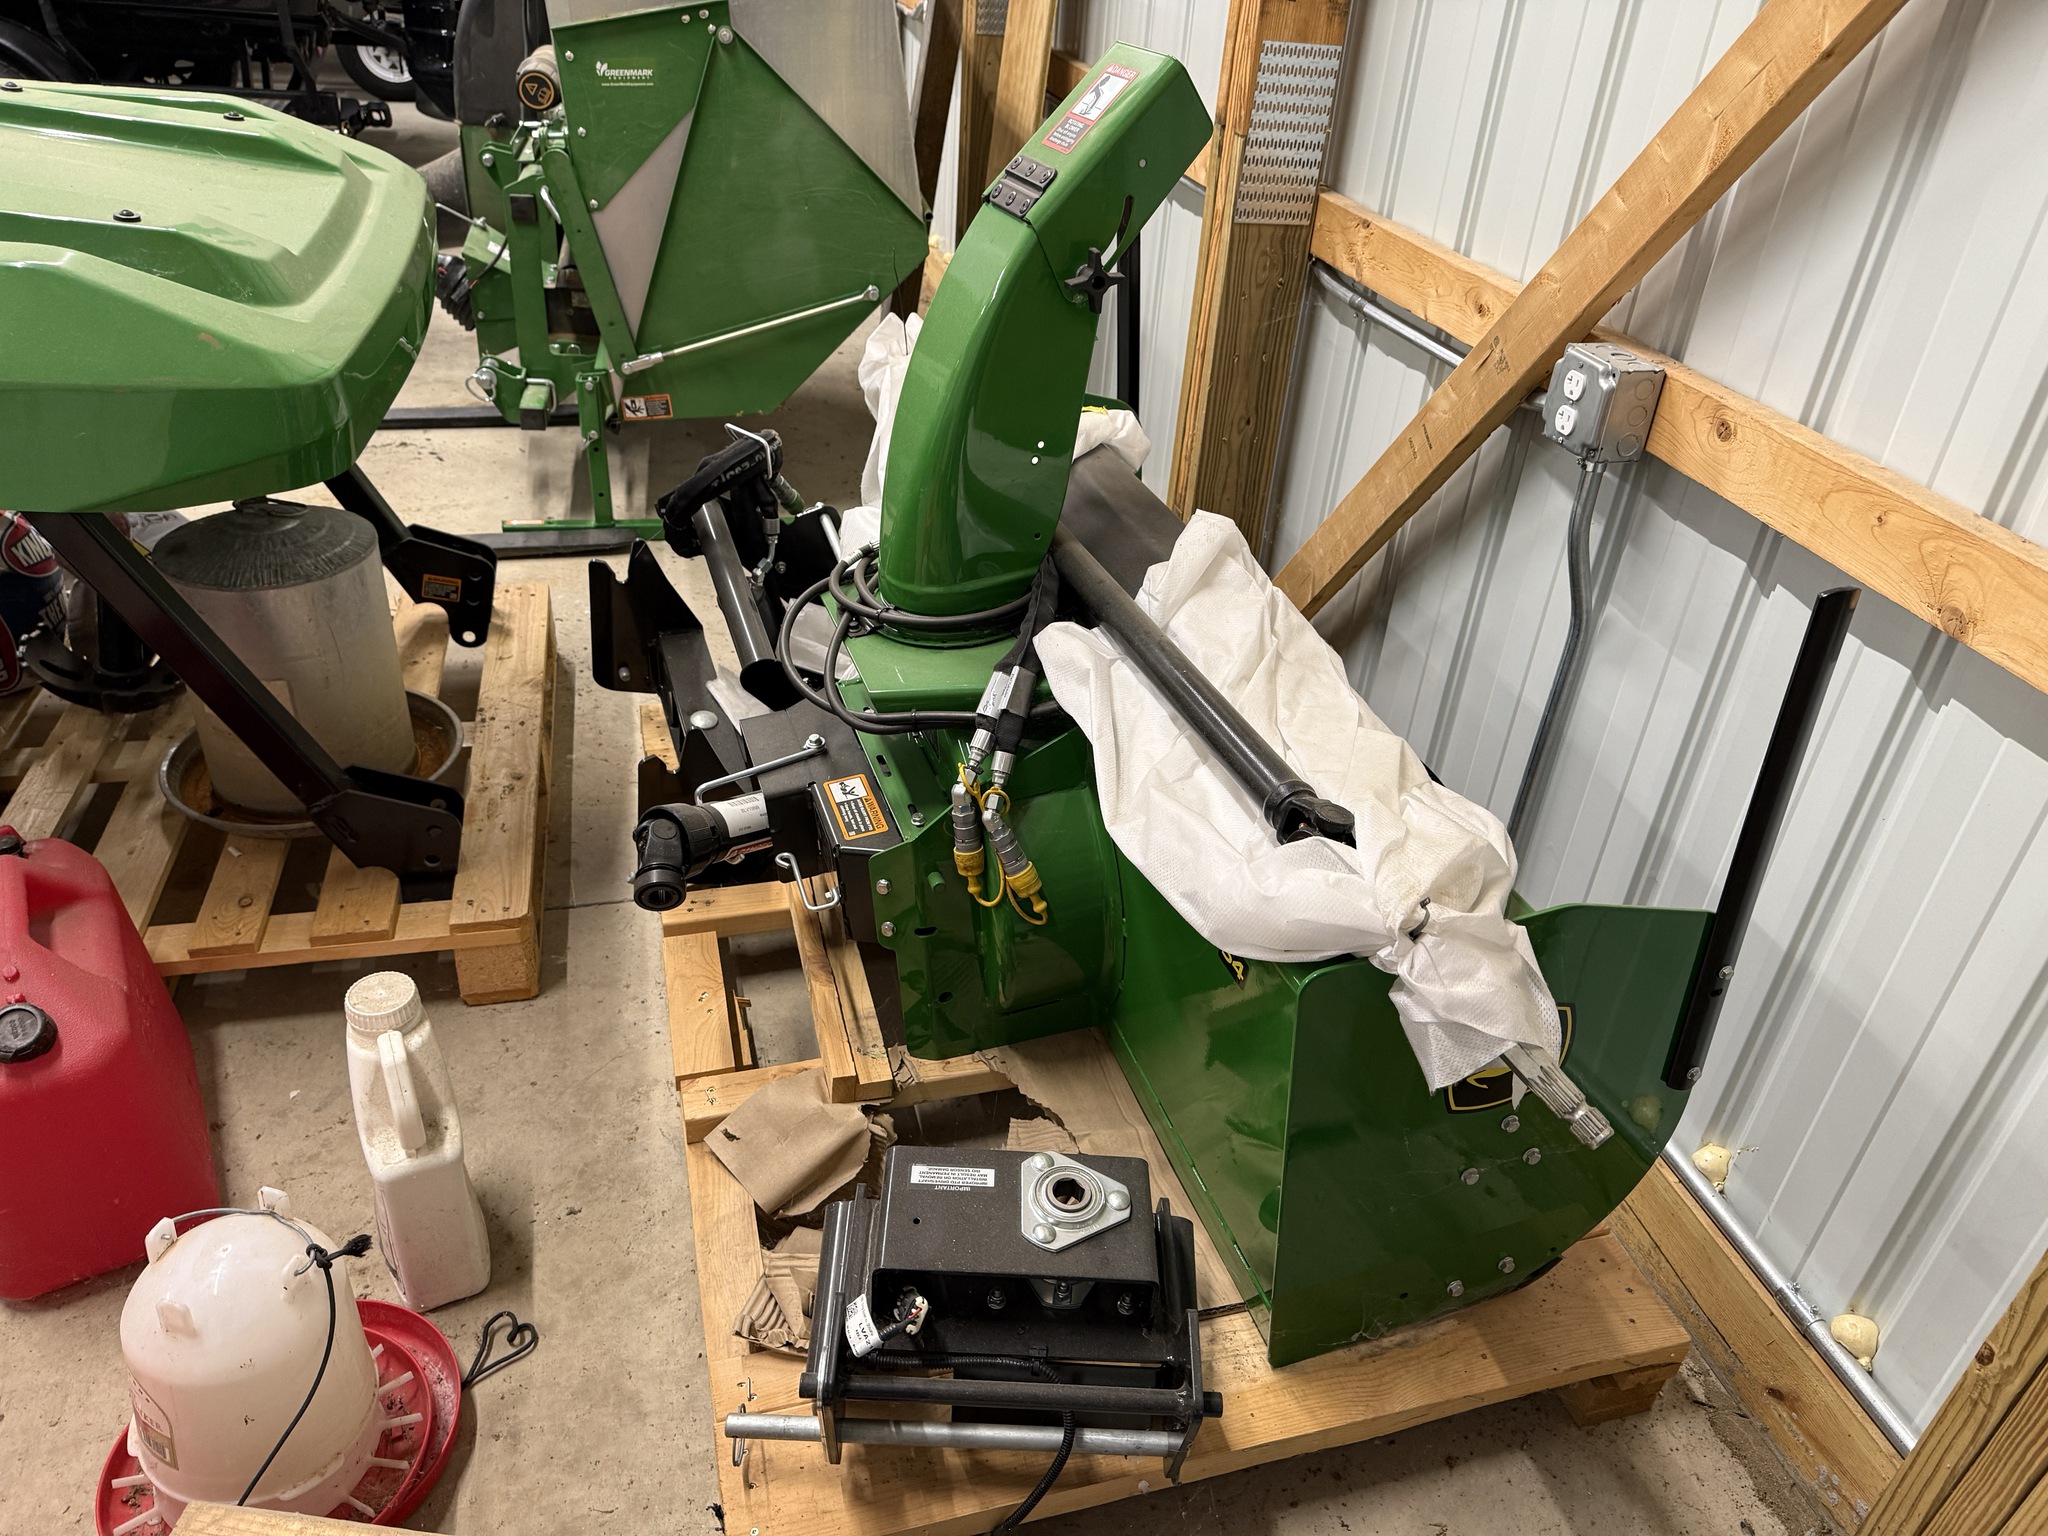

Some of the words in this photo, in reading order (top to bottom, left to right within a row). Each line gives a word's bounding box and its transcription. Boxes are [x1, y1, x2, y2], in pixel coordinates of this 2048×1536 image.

[605, 68, 653, 76] GREENMARK
[1112, 66, 1136, 79] DANGER
[867, 800, 884, 829] WARNING
